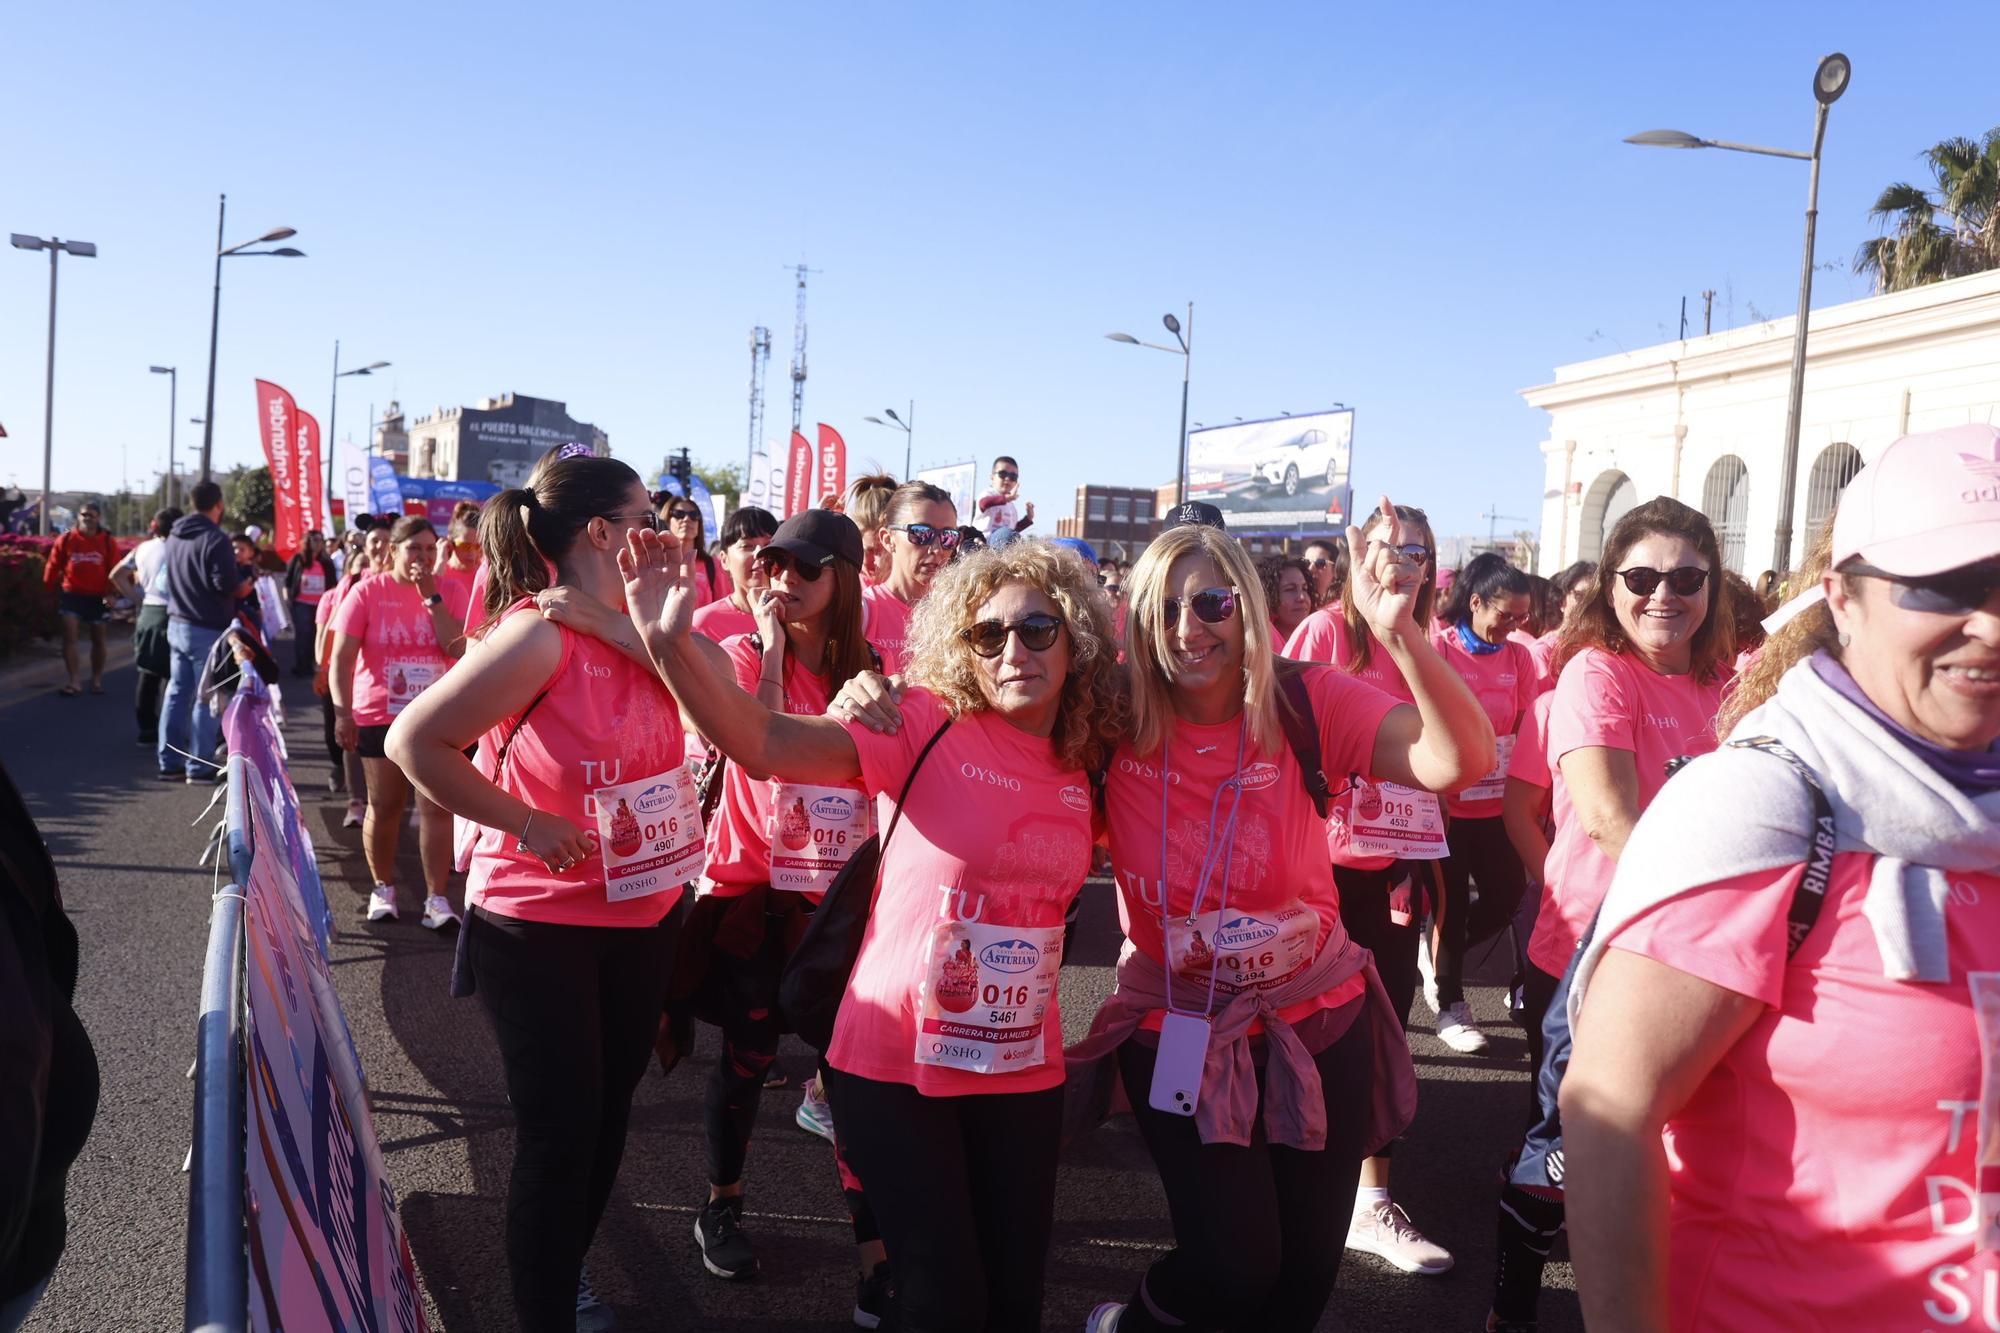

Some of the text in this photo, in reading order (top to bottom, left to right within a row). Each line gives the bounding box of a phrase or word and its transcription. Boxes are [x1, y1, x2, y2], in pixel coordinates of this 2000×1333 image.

[581, 759, 619, 785] TU
[961, 762, 1021, 792] OYSHO
[639, 792, 675, 811] ASTURIANA
[814, 804, 850, 816] ASTURIANA
[1385, 801, 1413, 817] 016
[644, 816, 678, 841] 016
[1390, 818, 1409, 828] 4532
[813, 829, 847, 844] 016
[1363, 828, 1388, 837] CARRERA
[1405, 832, 1421, 840] MUJER
[654, 838, 675, 853] 4907
[818, 847, 839, 857] 4910
[1359, 840, 1388, 850] OYSHO
[621, 861, 655, 875] CARRERA
[665, 855, 674, 863] LA
[674, 850, 690, 860] MUJER
[784, 859, 815, 868] CARRERA
[1803, 815, 1836, 895] BIMBA
[619, 876, 657, 893] OYSHO
[780, 873, 814, 884] OYSHO
[1122, 868, 1163, 906] TU
[938, 884, 984, 923] TU
[1278, 910, 1305, 923] SUMA
[1218, 929, 1275, 946] ASTURIANA
[985, 949, 1036, 966] ASTURIANA
[1226, 951, 1275, 970] 016
[1193, 976, 1233, 993] CARERA
[1259, 976, 1288, 990] MUJER
[1235, 970, 1266, 983] 5494
[982, 984, 1028, 1006] 016
[990, 1011, 1017, 1024] 5461
[939, 1025, 984, 1038] CARRERA
[985, 1031, 999, 1040] DE
[999, 1032, 1008, 1040] LA
[1008, 1030, 1030, 1039] MUJER
[932, 1042, 982, 1061] OYSHO
[1936, 1099, 1979, 1154] T
